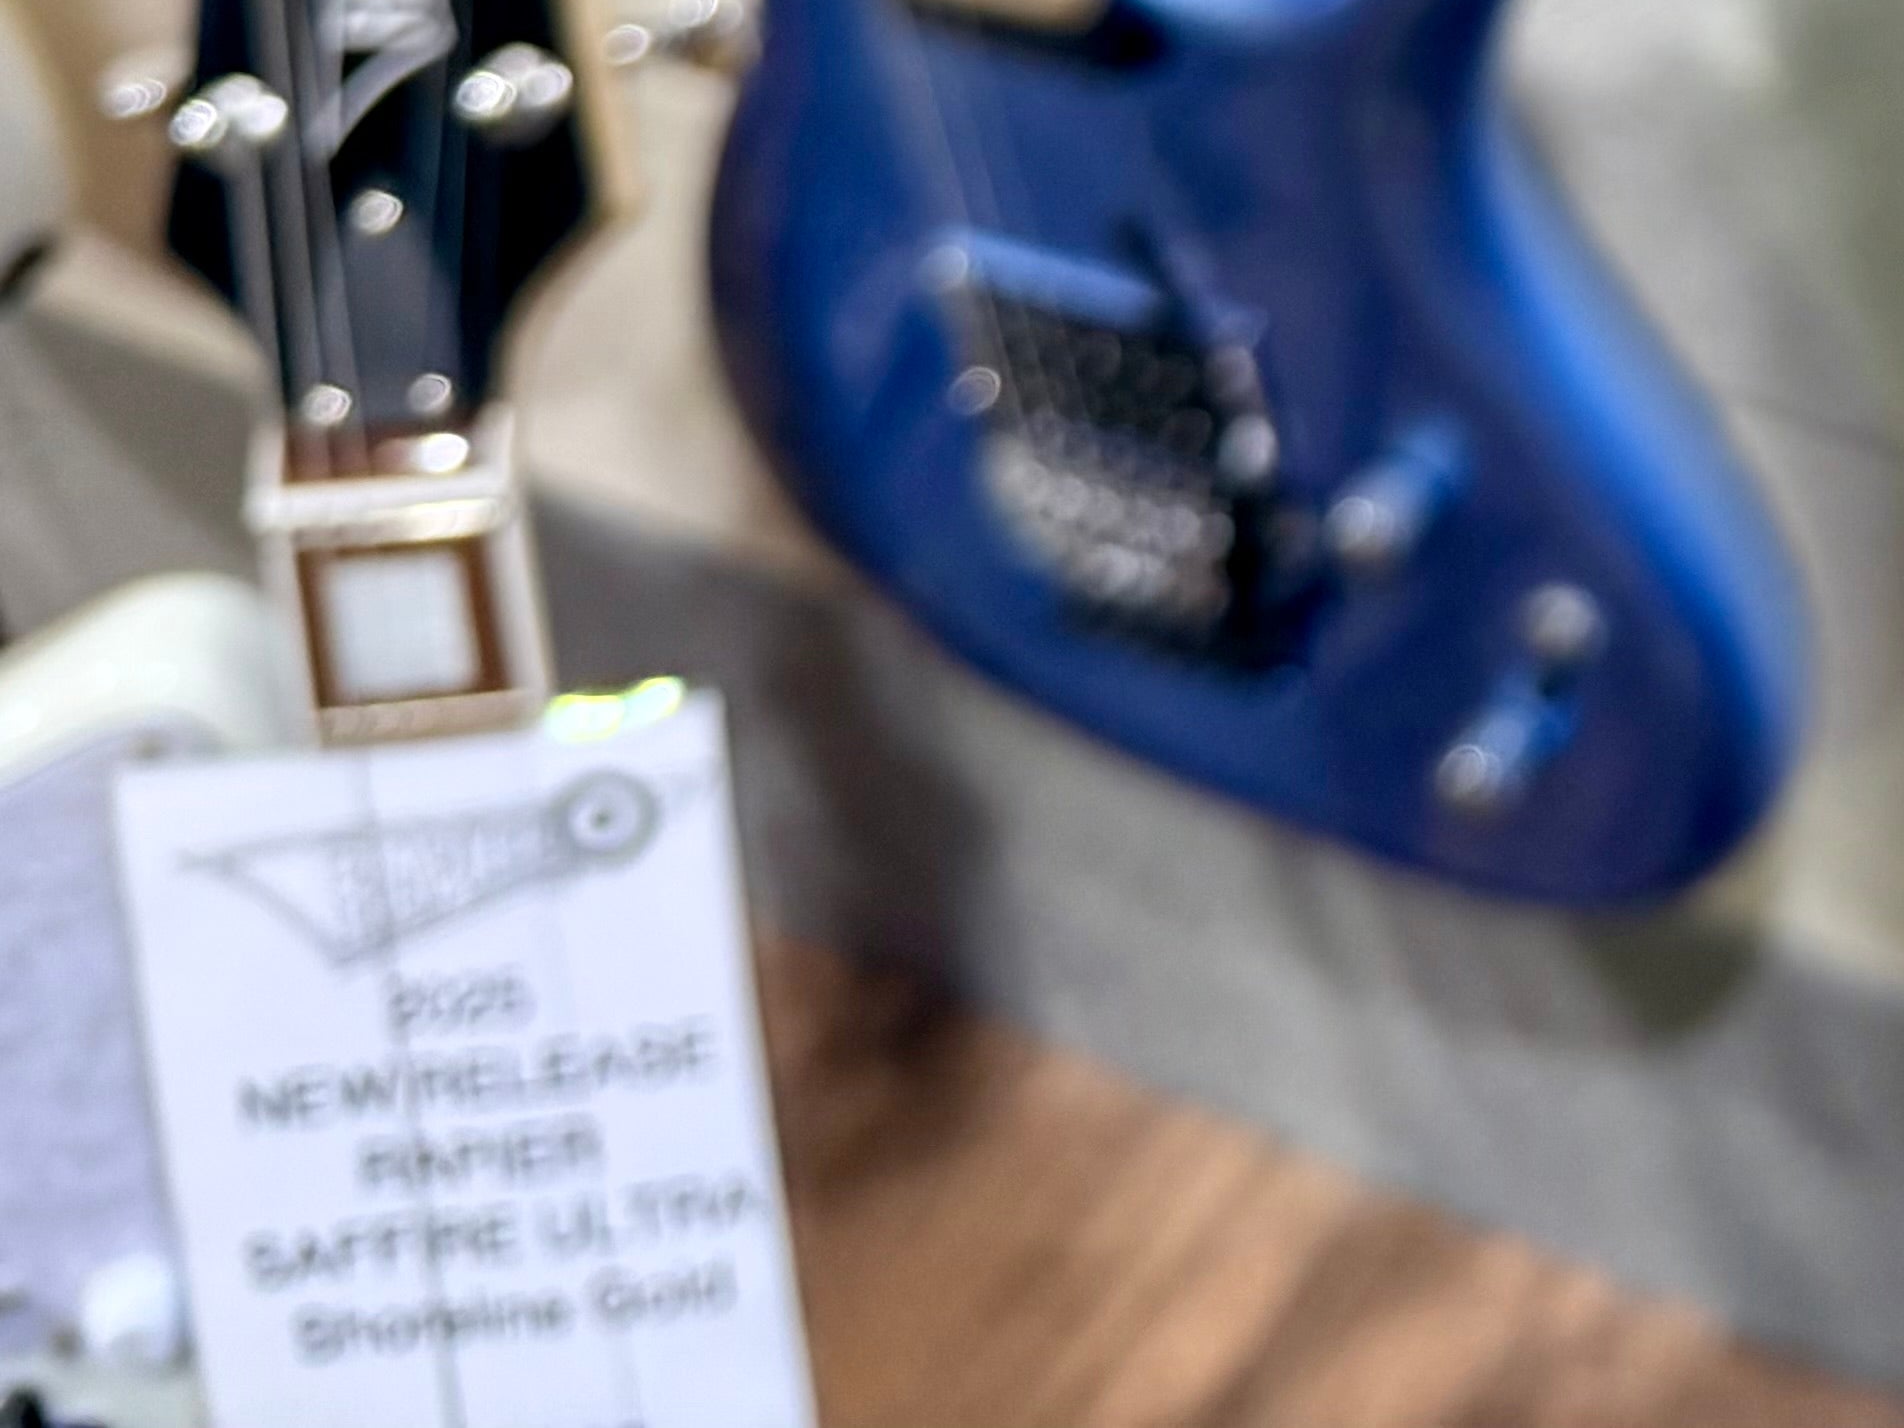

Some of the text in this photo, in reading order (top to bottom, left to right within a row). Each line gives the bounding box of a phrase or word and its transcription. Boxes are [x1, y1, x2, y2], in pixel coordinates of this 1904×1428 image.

[386, 970, 530, 1032] 2025
[238, 1022, 714, 1128] NEW RELEASE
[244, 1206, 518, 1286] SAFFIRE
